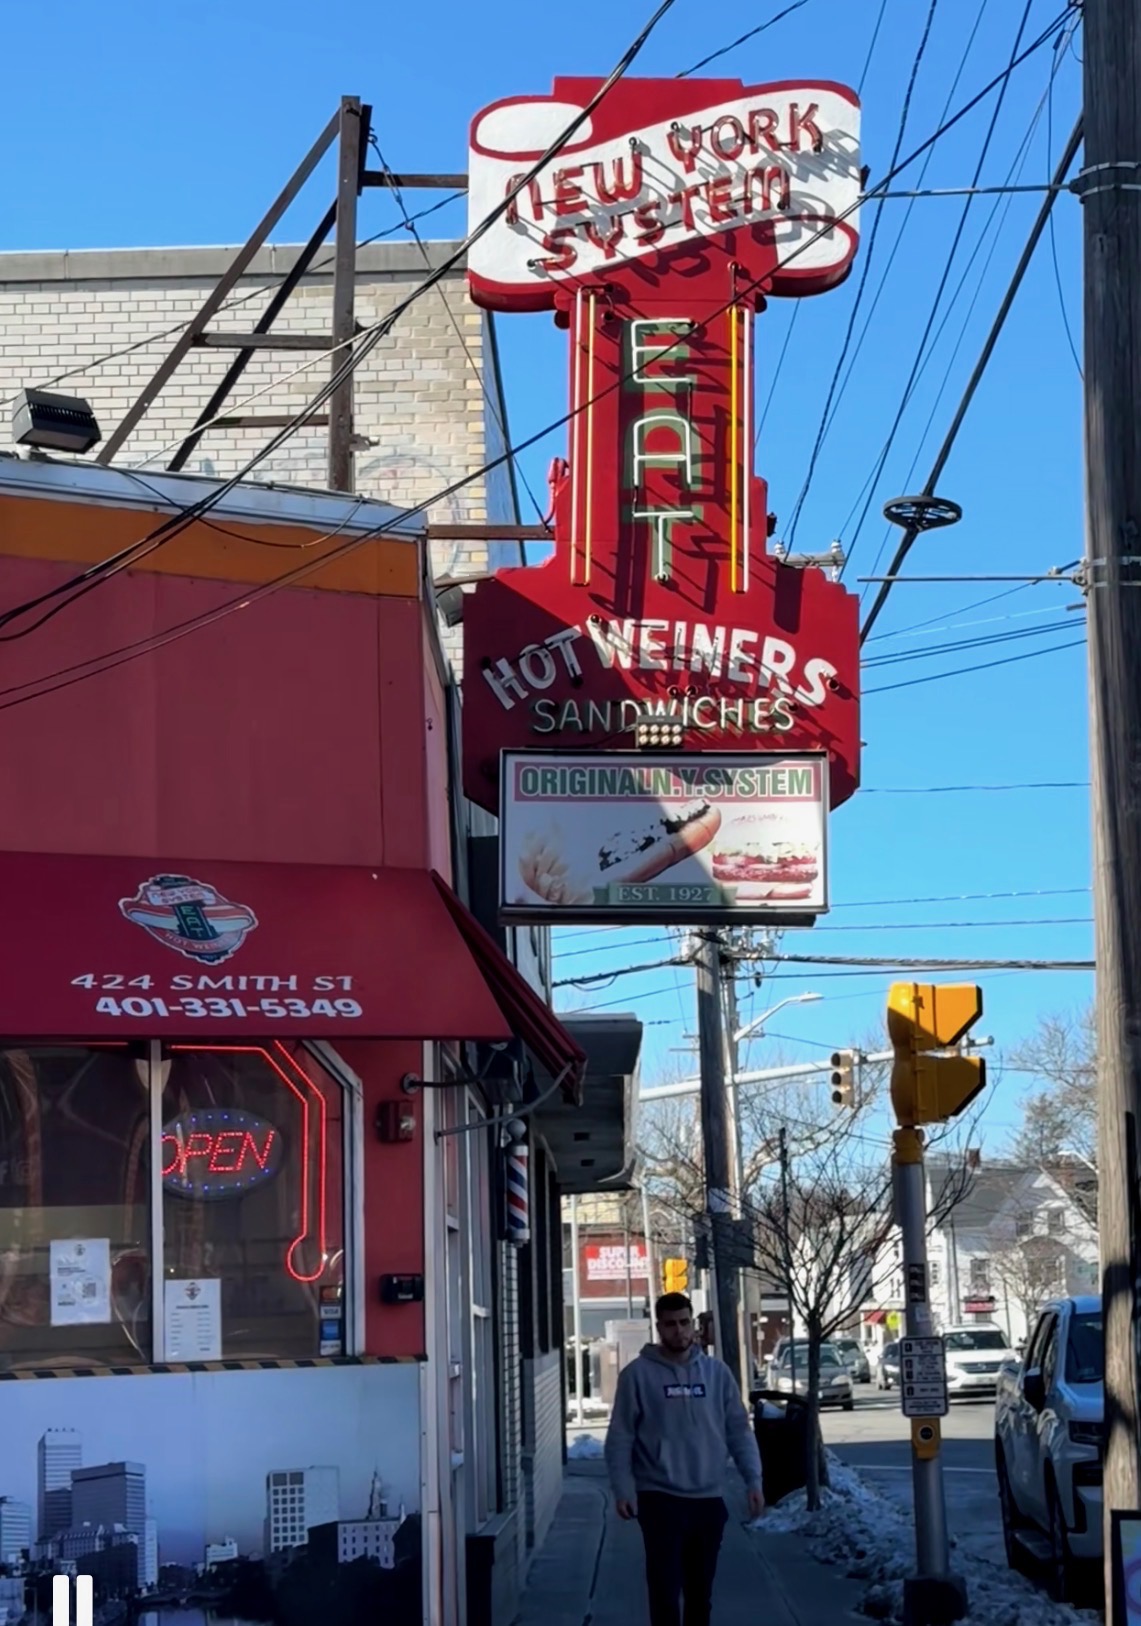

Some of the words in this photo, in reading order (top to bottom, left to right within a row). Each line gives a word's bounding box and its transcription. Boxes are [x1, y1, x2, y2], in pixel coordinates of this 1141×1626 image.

[505, 144, 643, 226] NEW
[667, 102, 824, 174] YORK
[540, 165, 791, 271] SYSTEM
[624, 318, 703, 582] EAT
[481, 625, 583, 711] HOT
[586, 617, 839, 708] WEINERS
[532, 697, 797, 733] SANDWICHES
[618, 886, 660, 901] EST.
[670, 887, 715, 901] 1927
[70, 973, 155, 990] 424
[169, 974, 298, 991] SMITH
[312, 975, 355, 991] ST
[95, 996, 363, 1018] 401-331-5349
